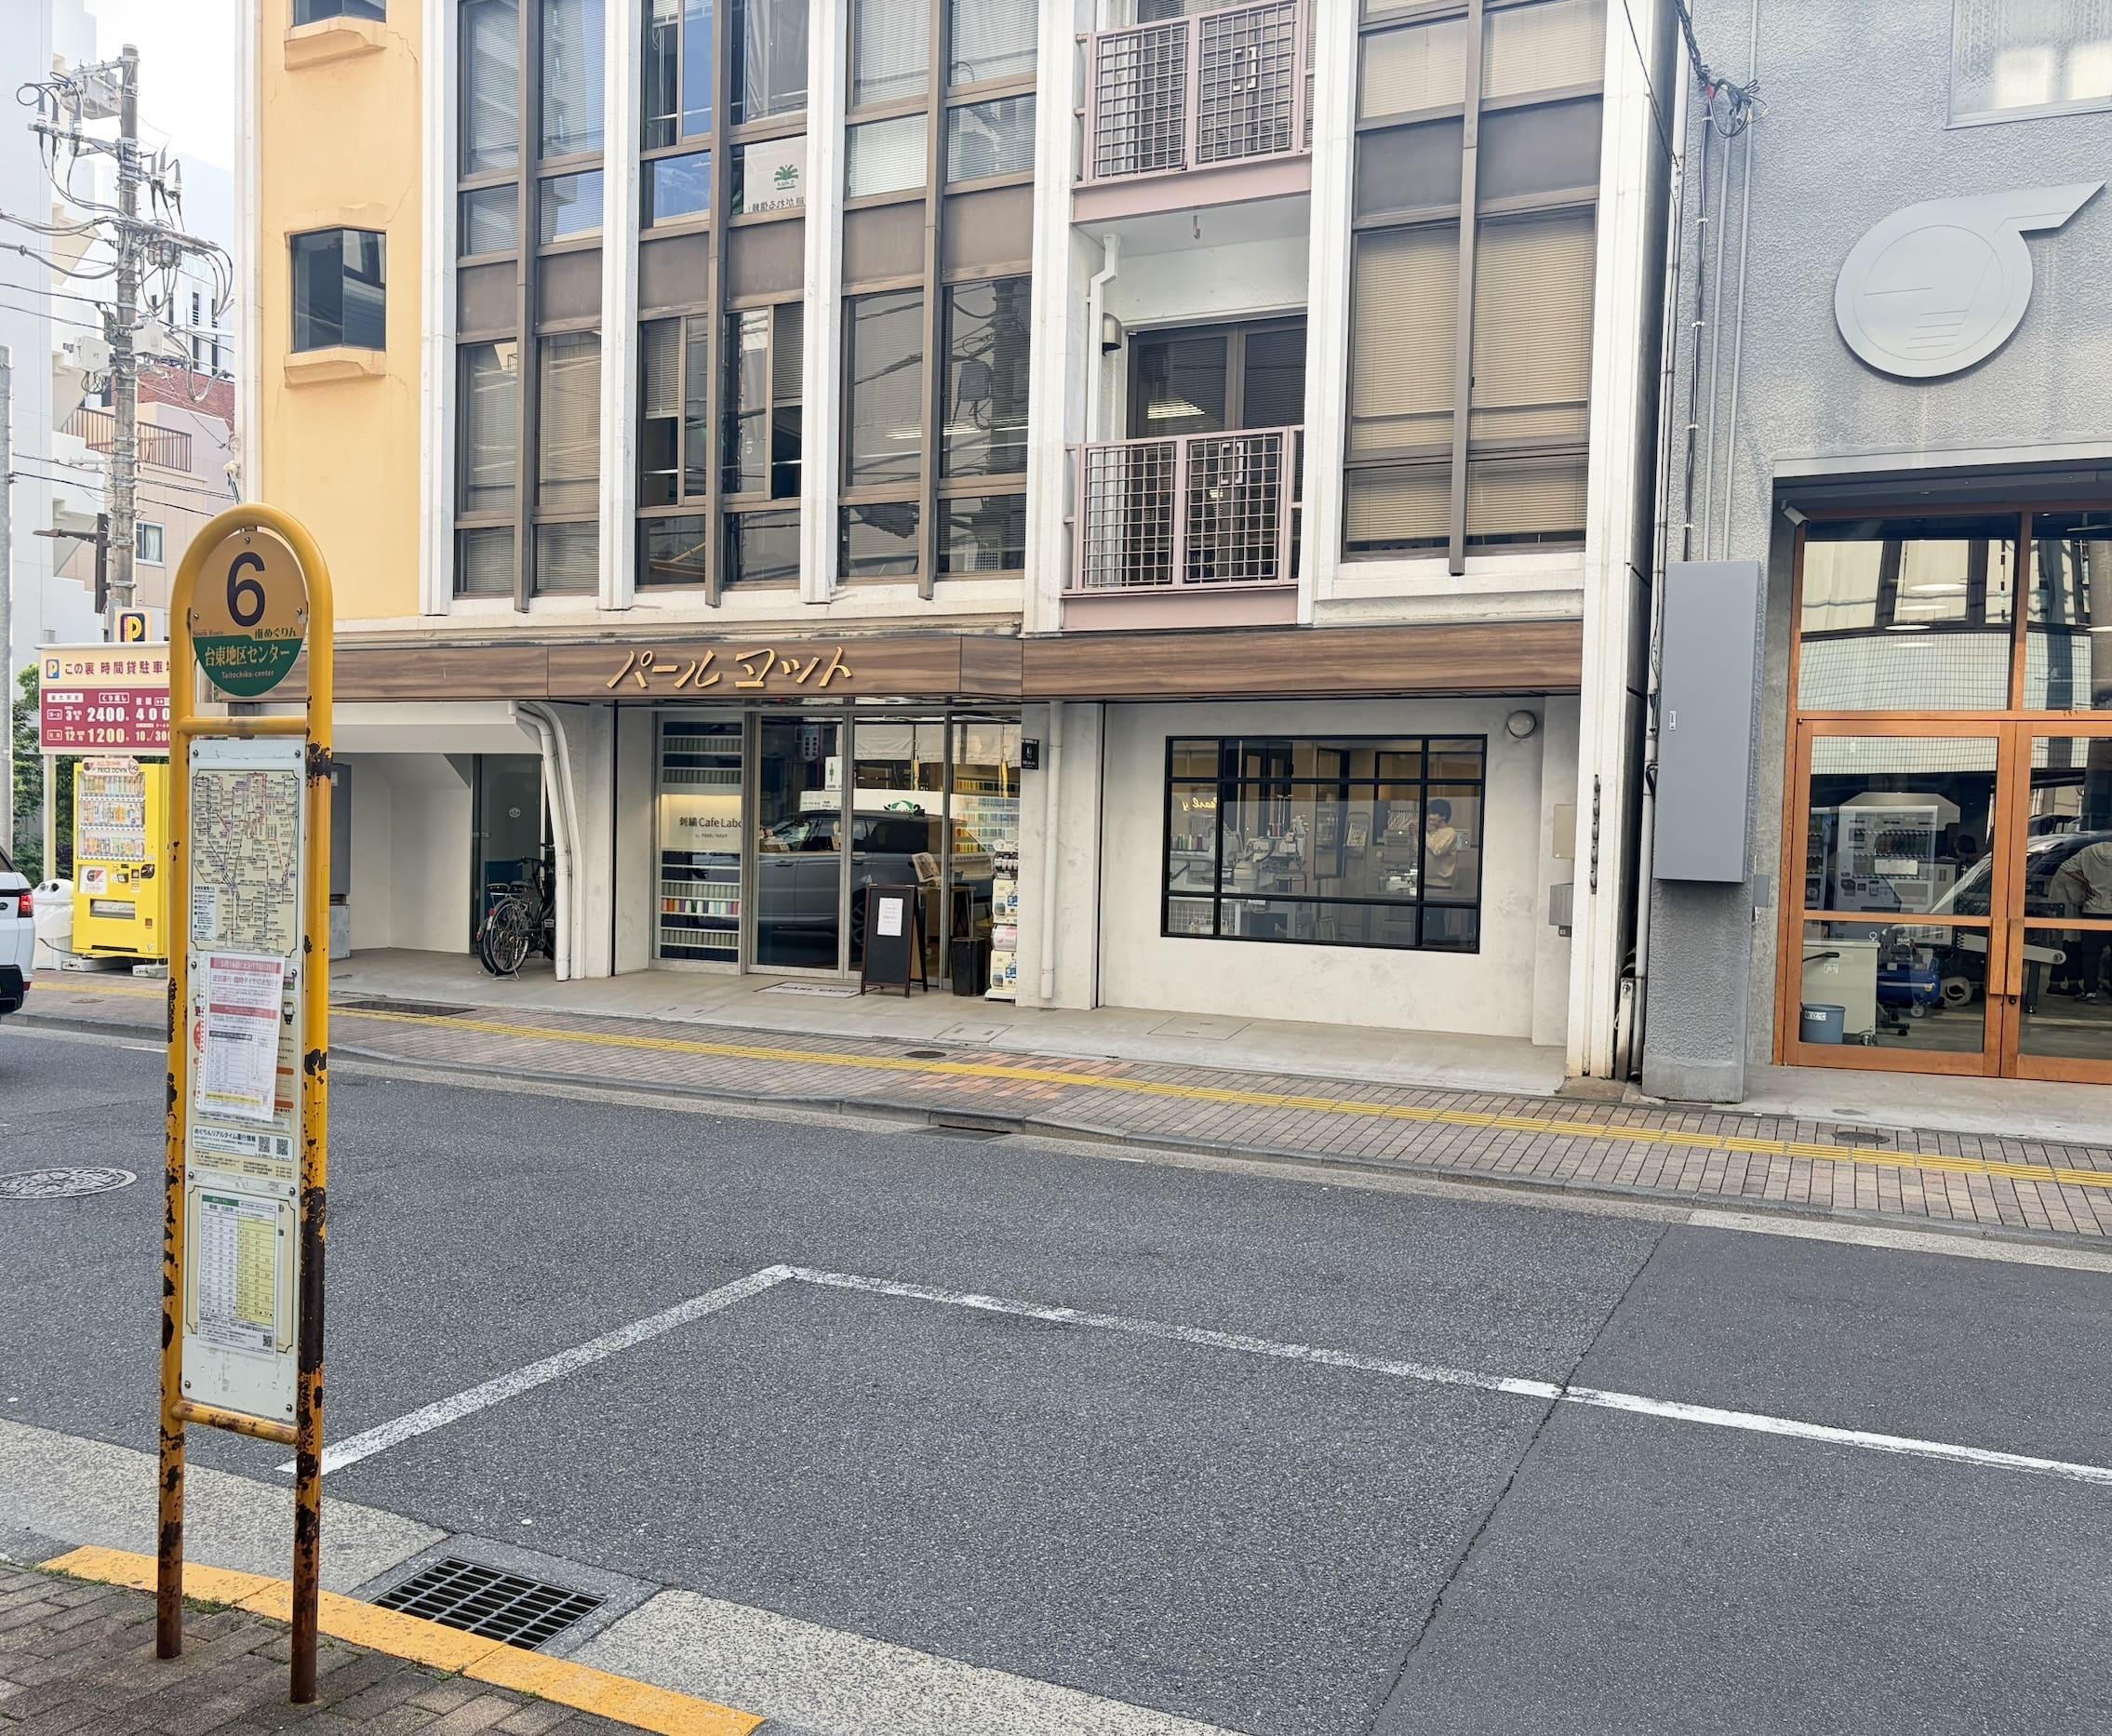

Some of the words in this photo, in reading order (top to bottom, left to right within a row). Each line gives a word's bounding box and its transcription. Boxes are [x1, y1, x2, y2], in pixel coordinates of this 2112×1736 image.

[226, 551, 266, 627] 6
[254, 626, 297, 639] 南めぐりん
[205, 643, 290, 667] 台東地区センター
[64, 661, 95, 675] この裏
[221, 669, 274, 679] Taitochiku-center
